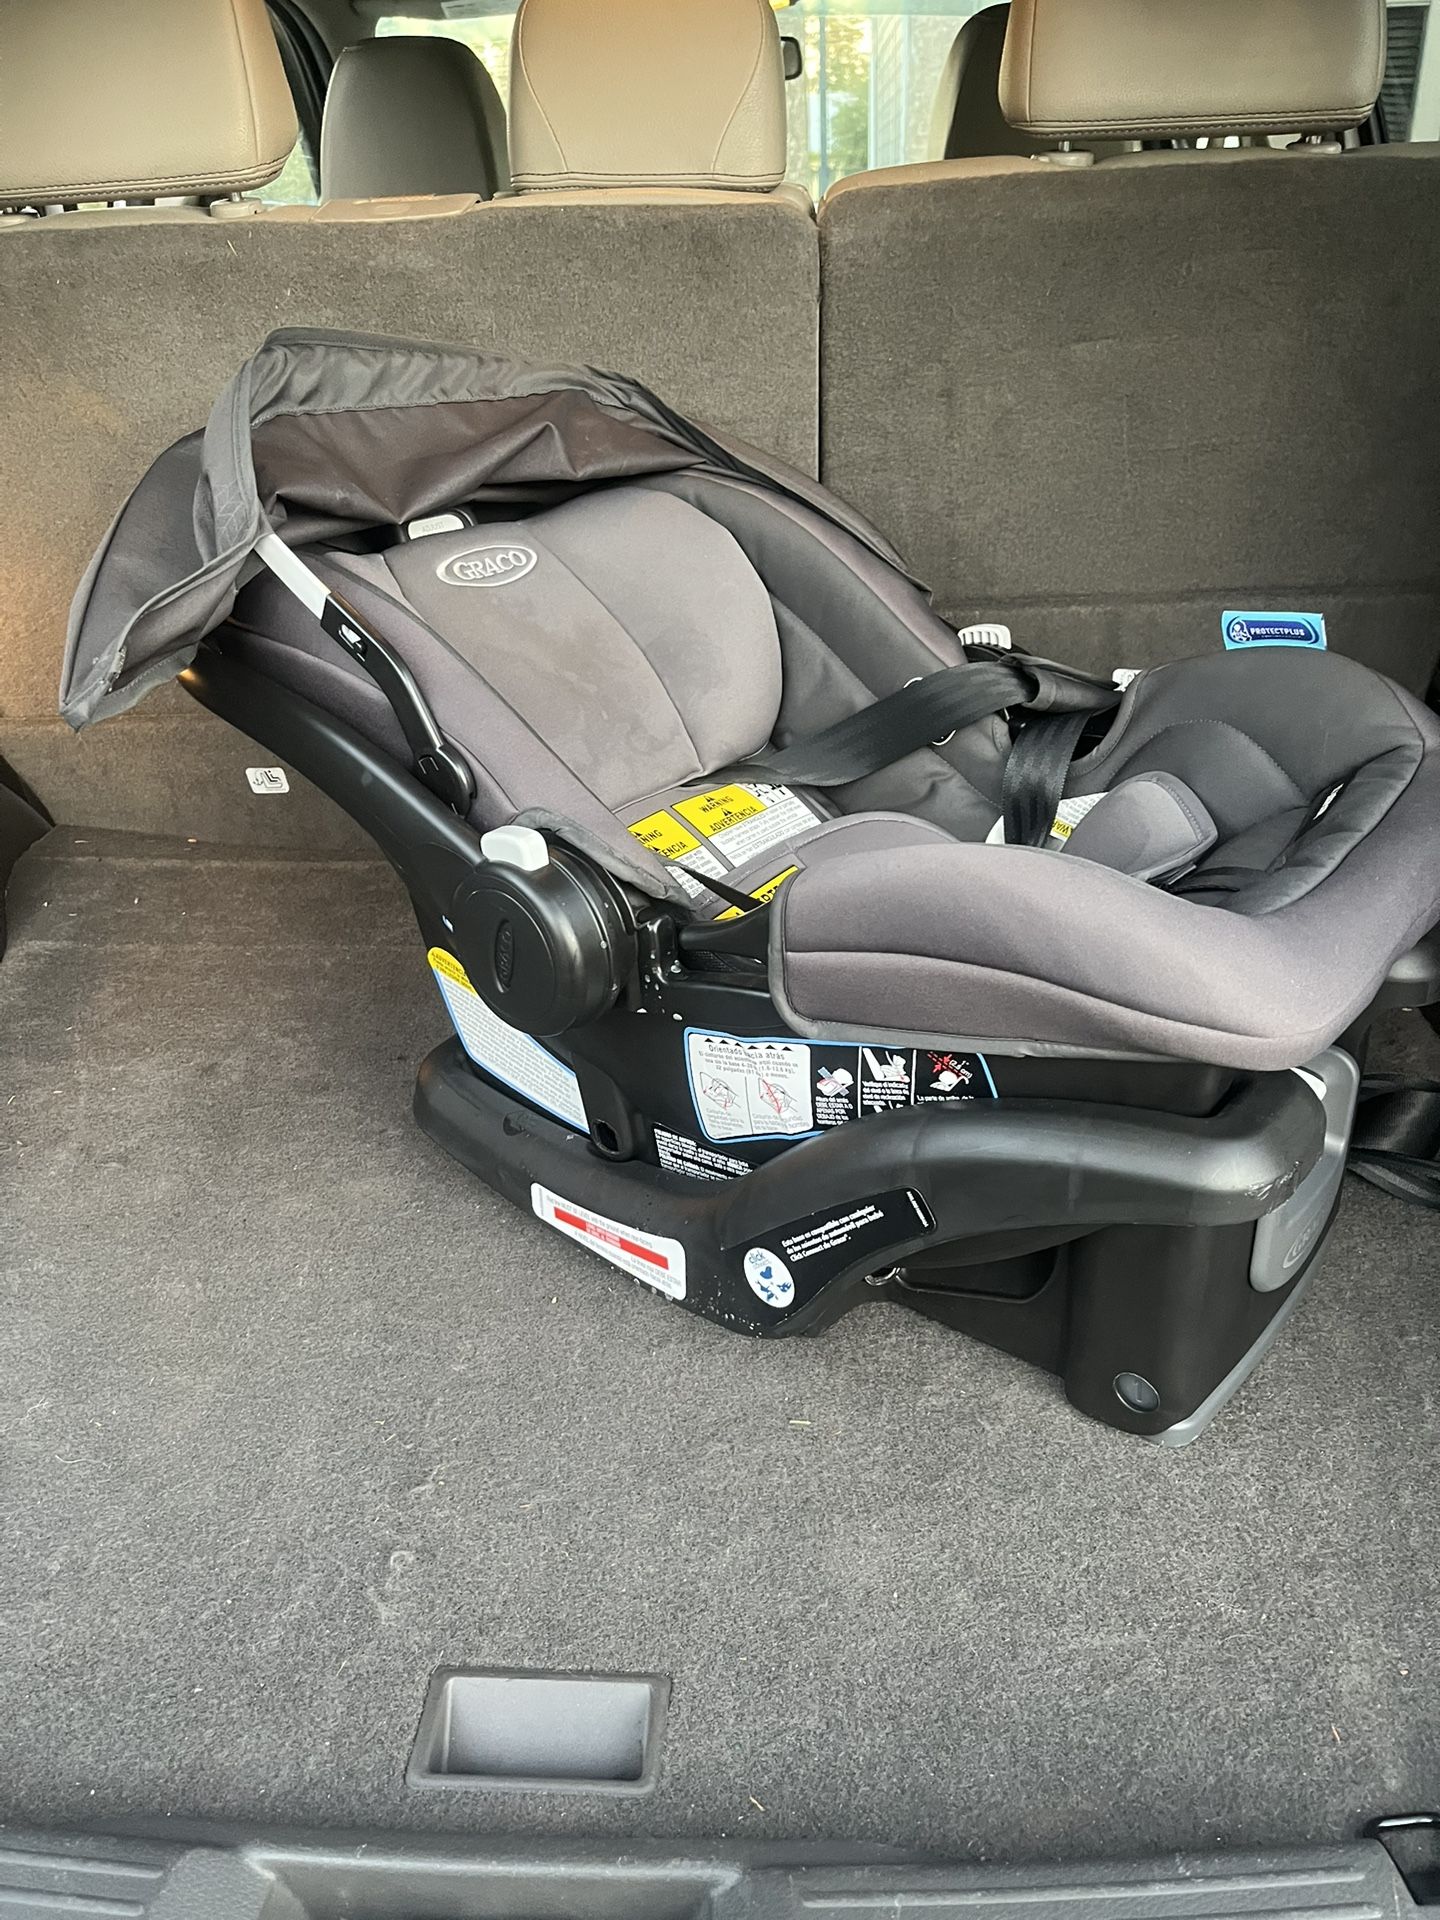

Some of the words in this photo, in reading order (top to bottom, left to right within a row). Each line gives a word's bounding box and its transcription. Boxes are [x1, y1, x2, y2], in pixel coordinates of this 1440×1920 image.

[453, 550, 526, 580] GRACO
[1250, 627, 1305, 636] PROTECTPLUS
[700, 795, 734, 813] WARNING
[709, 806, 758, 832] ADVERTENCIA
[708, 1044, 743, 1056] Orientado
[744, 1049, 763, 1059] hacia
[766, 1050, 785, 1060] atrás
[749, 1250, 765, 1264] click
